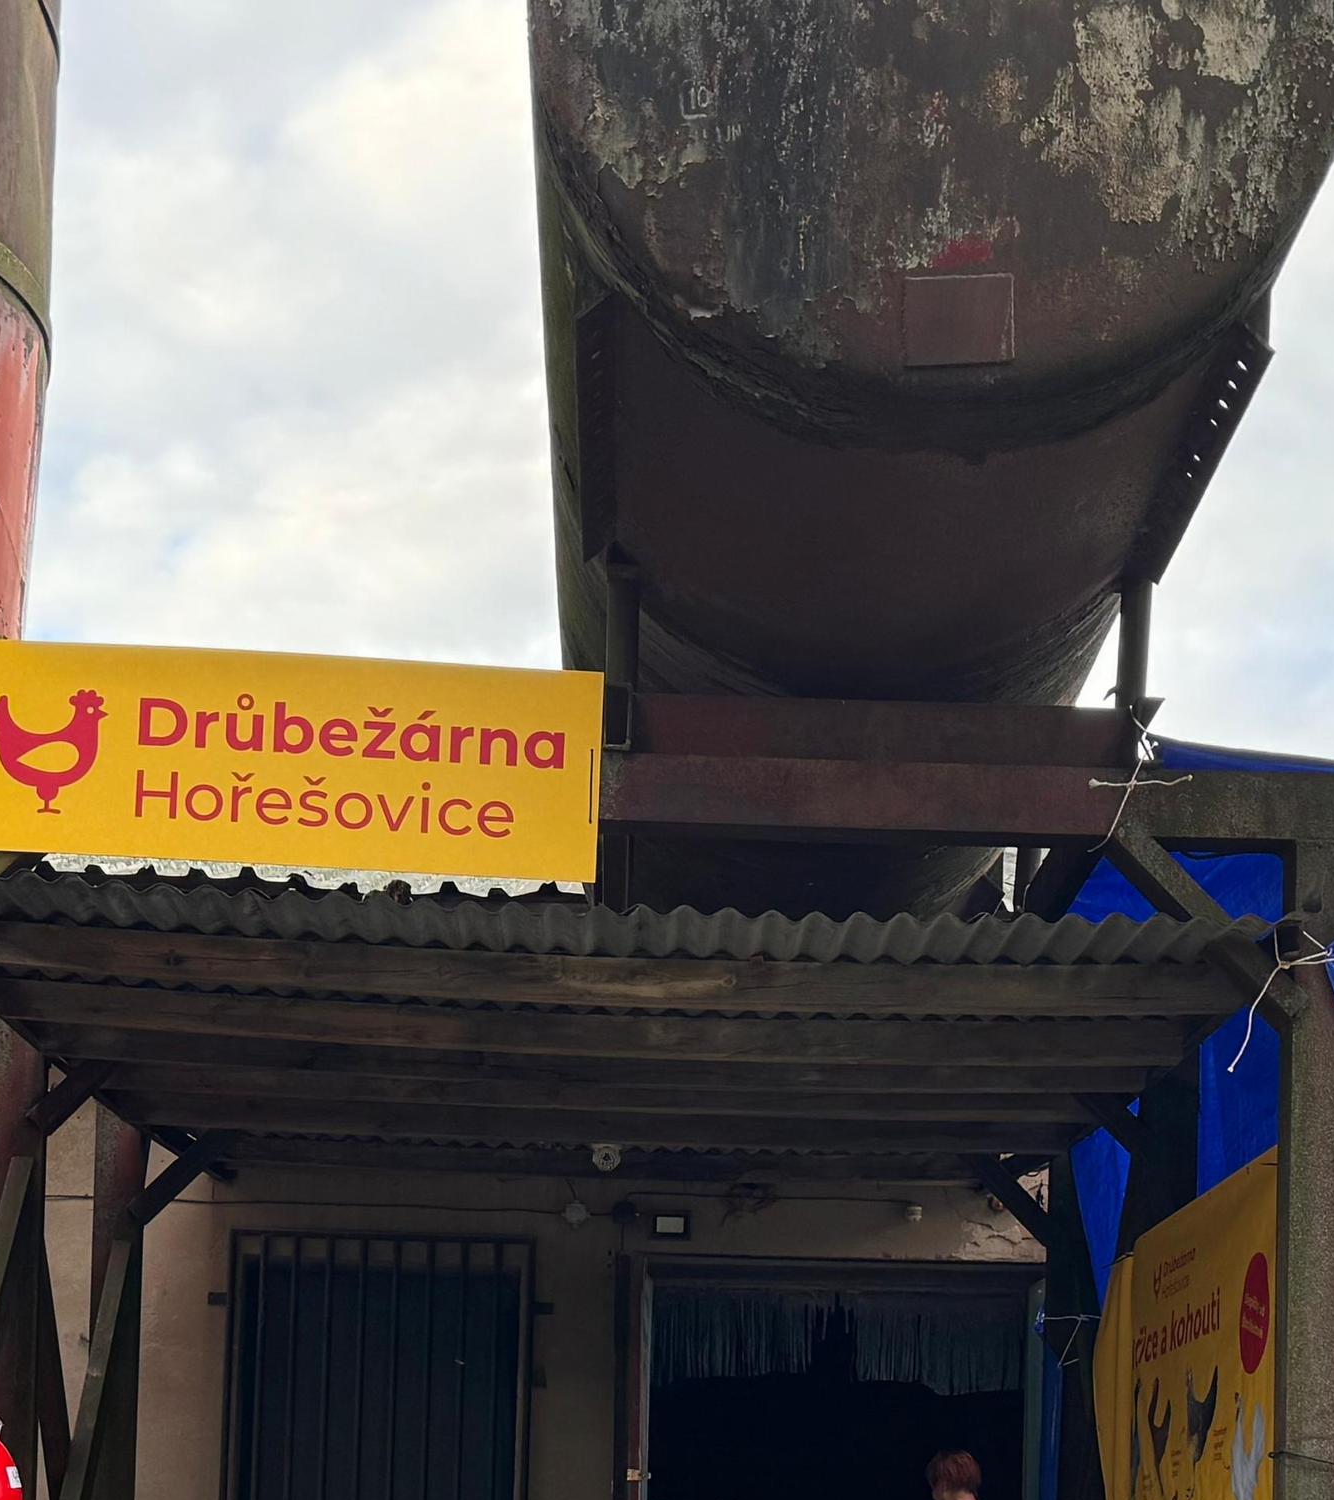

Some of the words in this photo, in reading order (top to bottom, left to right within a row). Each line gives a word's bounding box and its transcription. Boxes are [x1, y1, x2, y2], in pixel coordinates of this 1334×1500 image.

[137, 694, 566, 769] Drůbežárna
[134, 770, 515, 839] Hořešovice
[1170, 1287, 1220, 1351] kohouti
